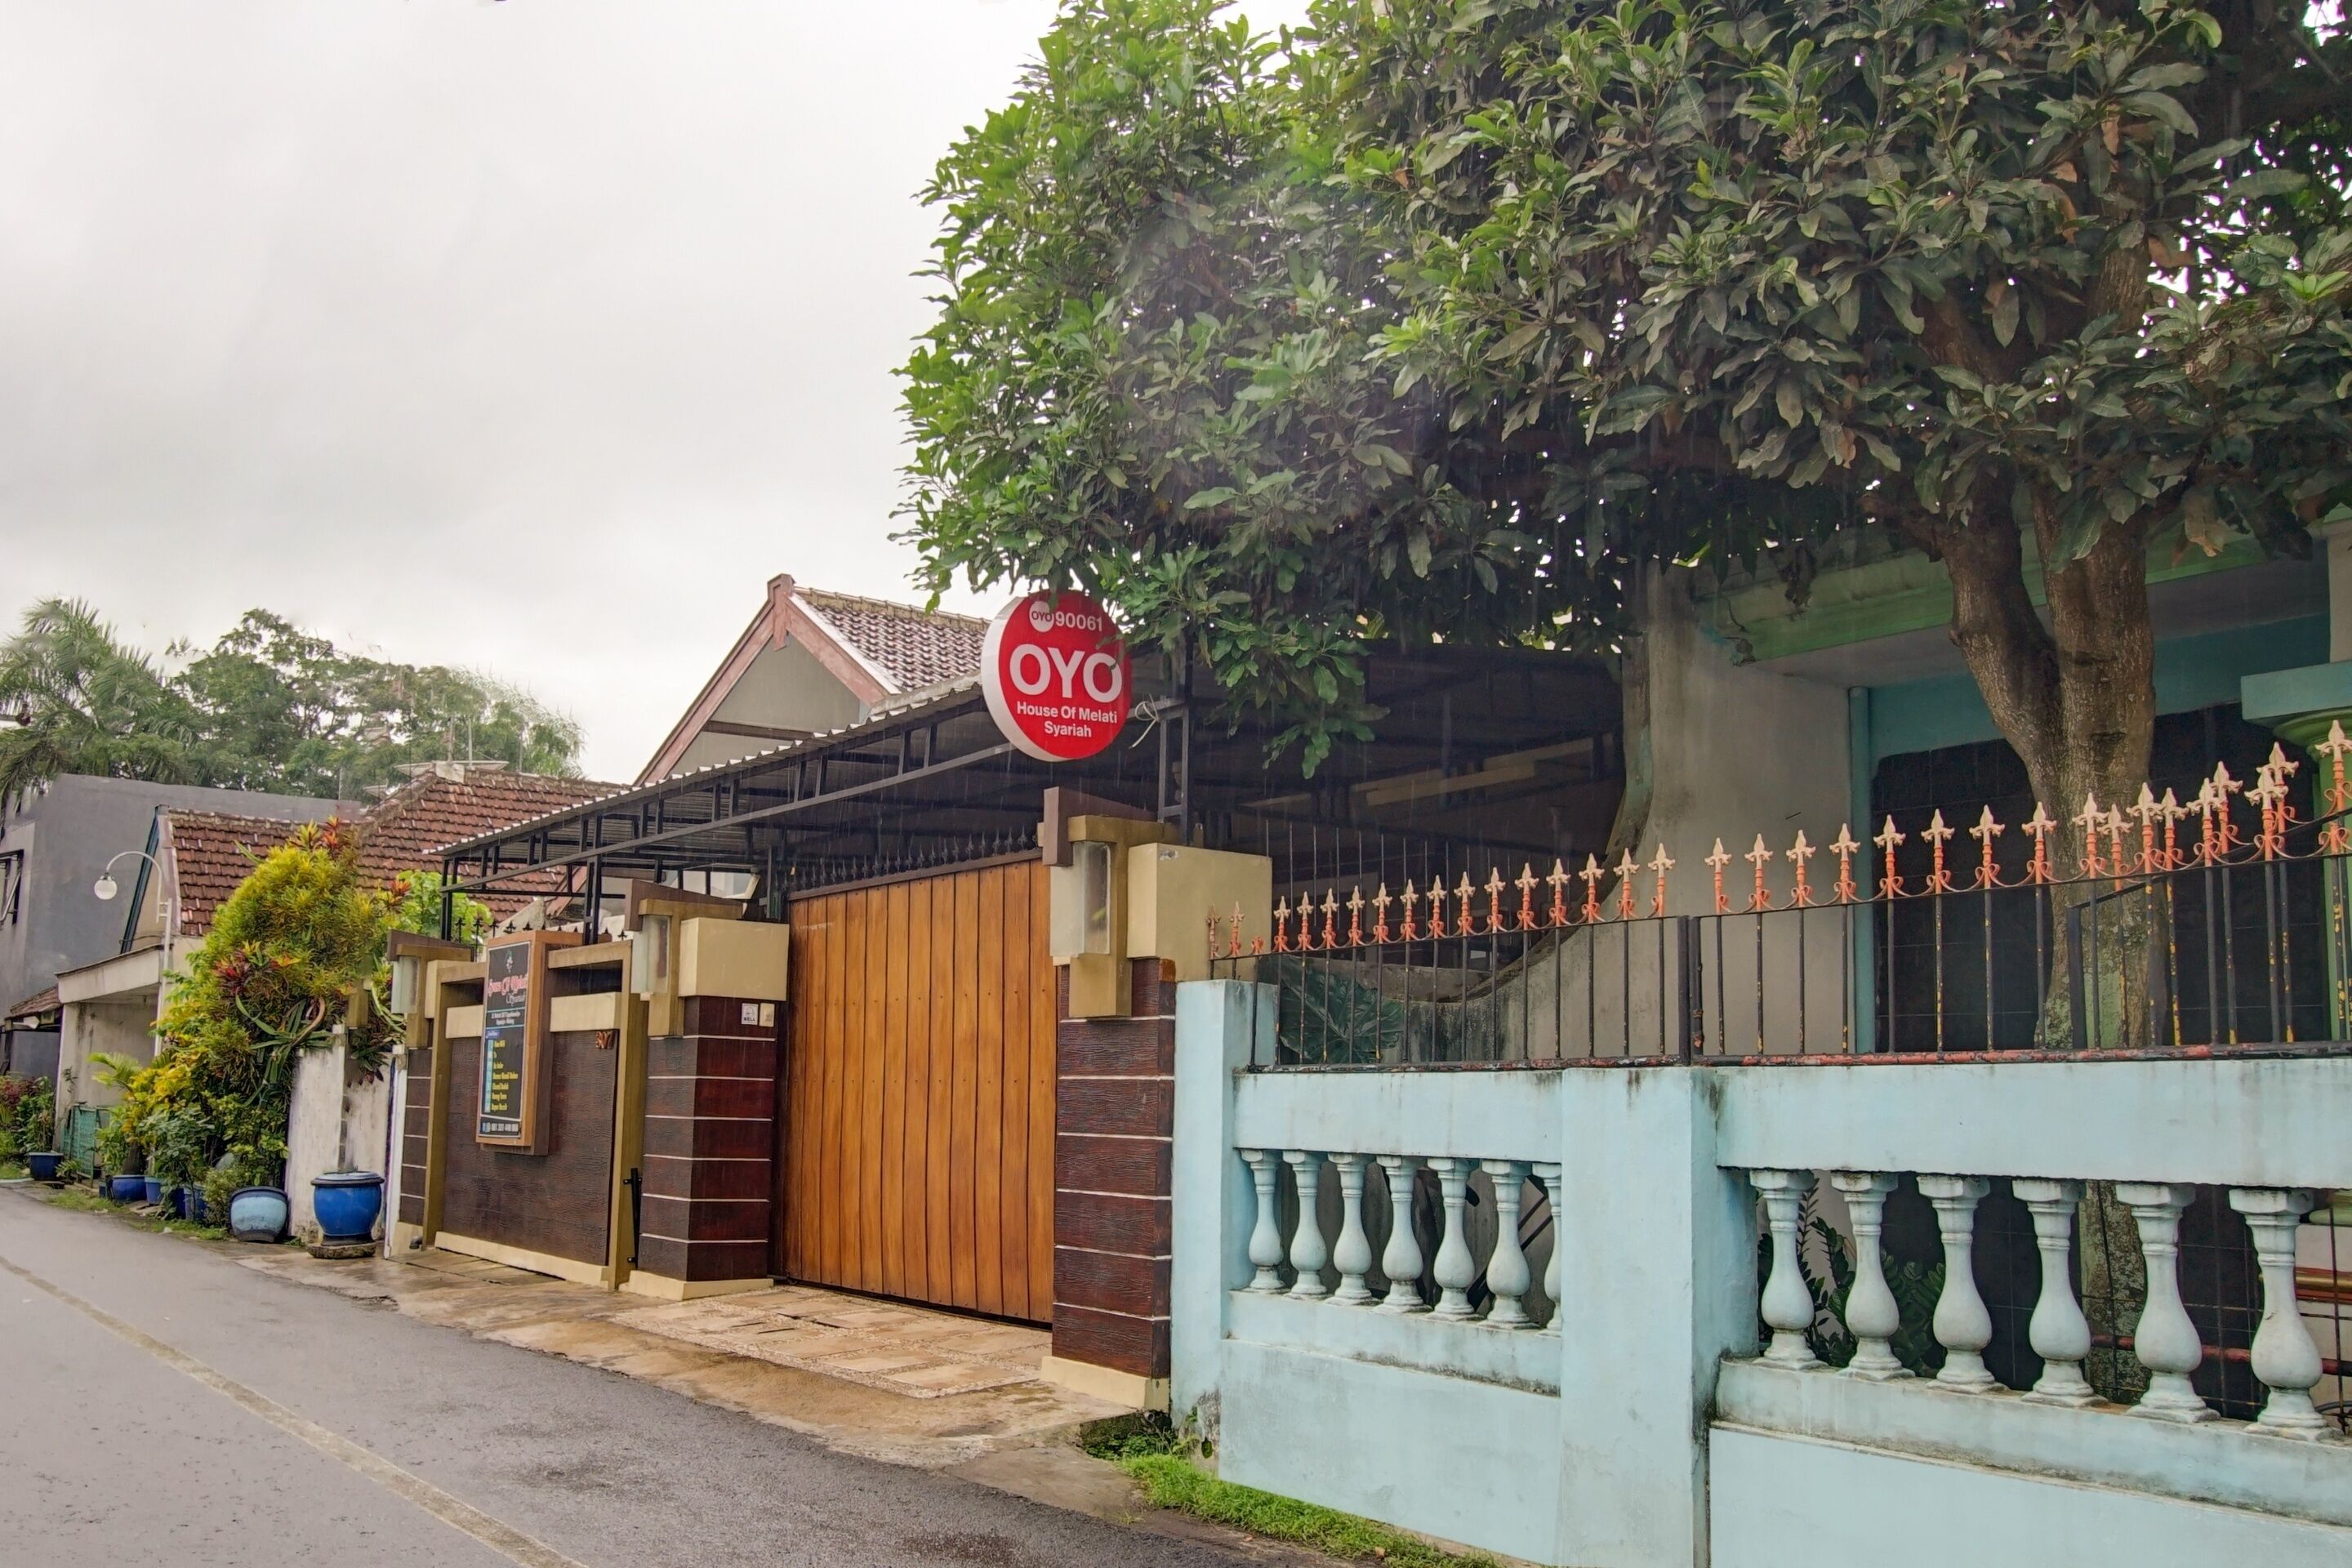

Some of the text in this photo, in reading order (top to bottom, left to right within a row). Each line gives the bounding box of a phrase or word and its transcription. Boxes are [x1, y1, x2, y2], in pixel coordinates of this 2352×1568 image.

[1031, 611, 1102, 632] OYO 90061
[1009, 644, 1123, 703] OYO
[1017, 701, 1118, 724] House Of Melati
[1045, 721, 1092, 737] Syariah
